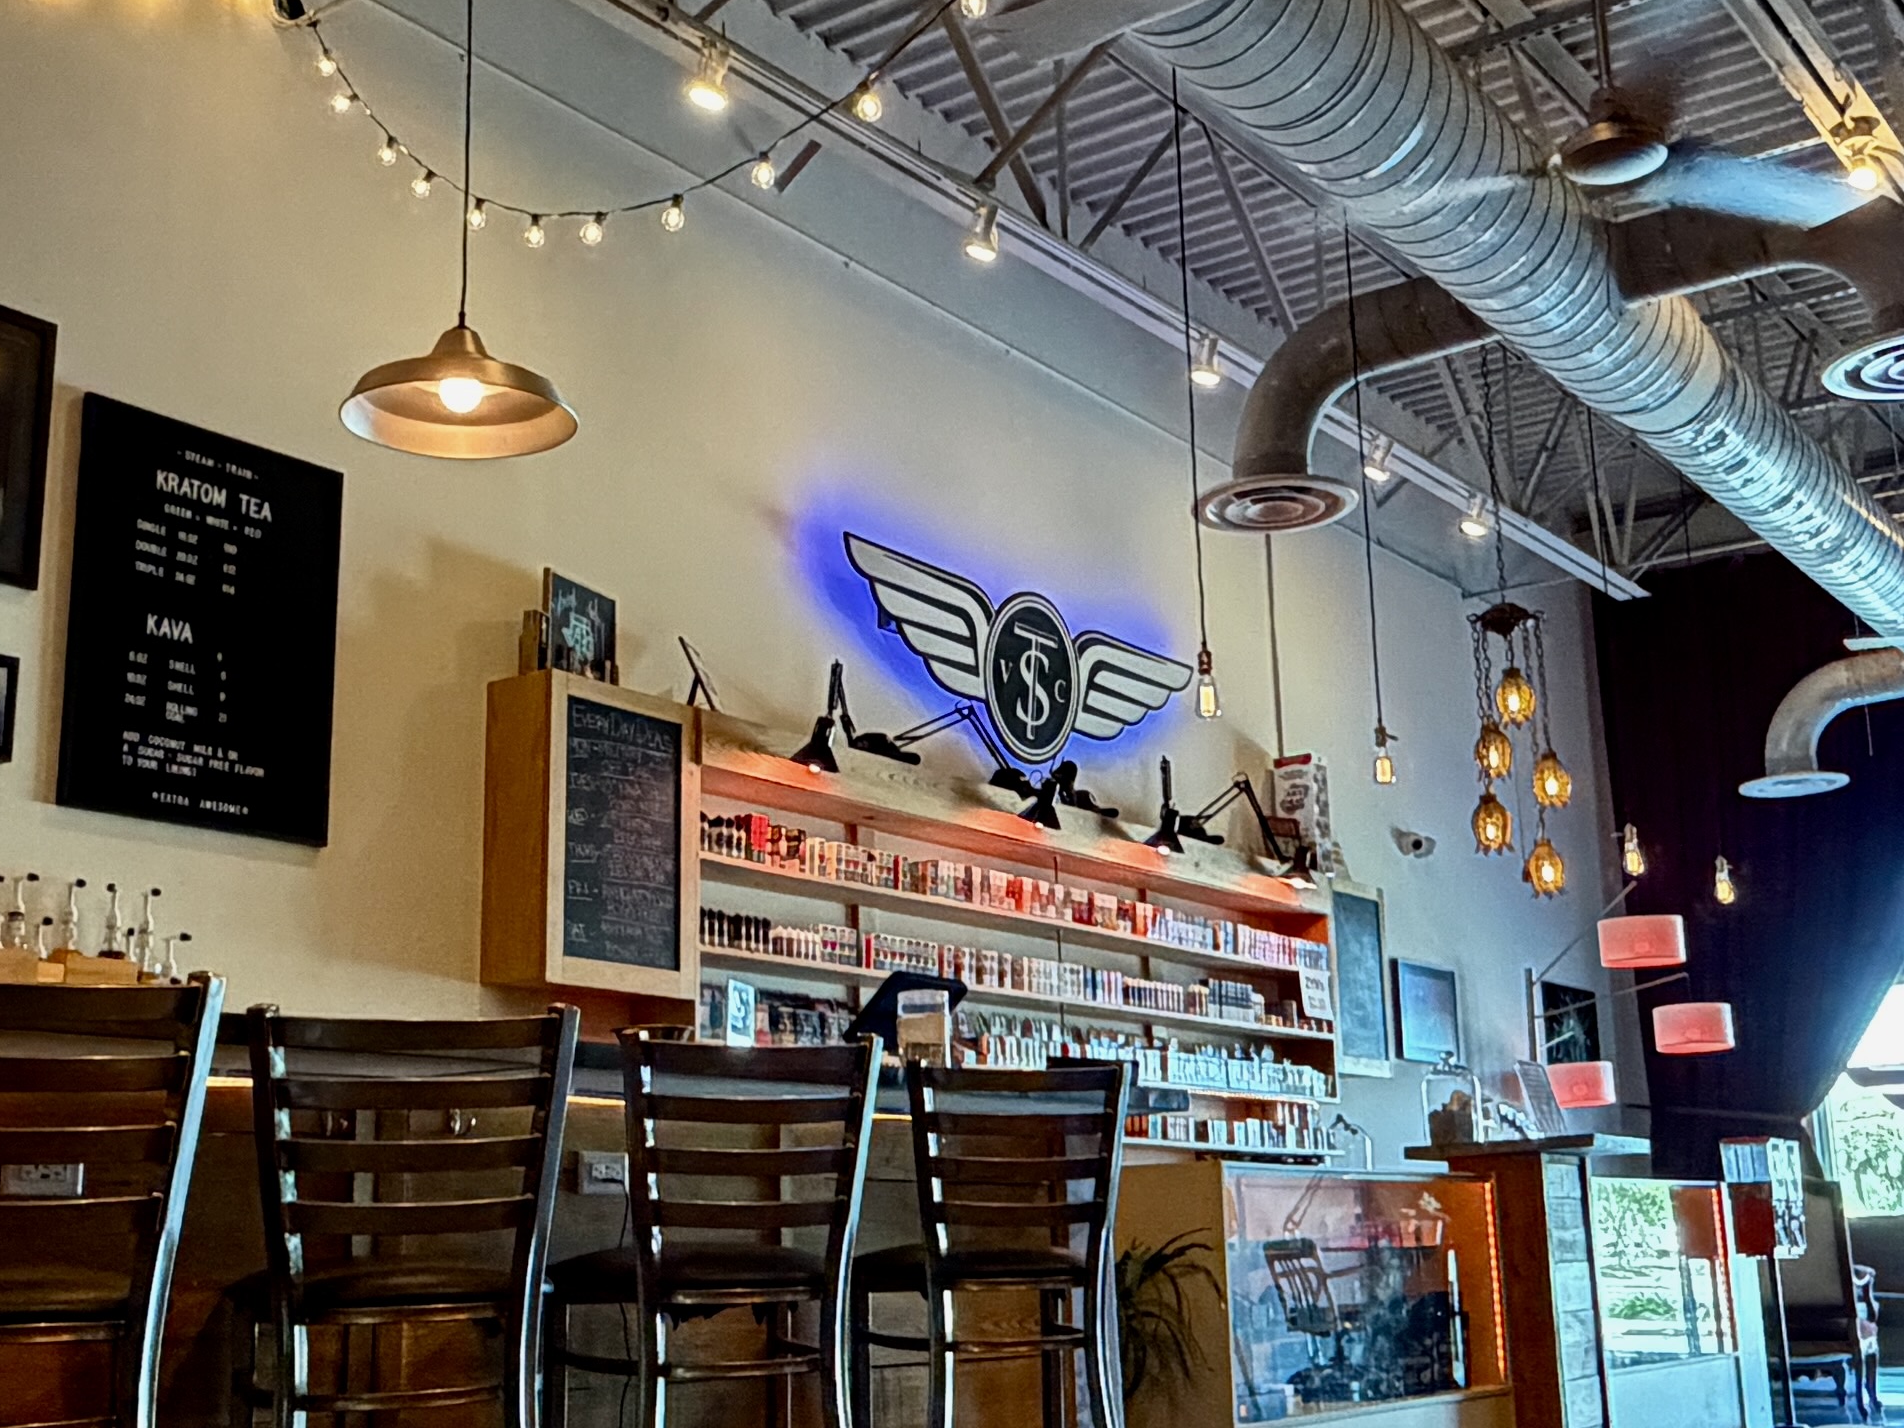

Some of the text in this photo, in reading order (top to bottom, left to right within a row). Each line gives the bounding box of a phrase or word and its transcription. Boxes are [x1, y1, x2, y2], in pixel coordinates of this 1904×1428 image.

[156, 469, 272, 522] KRATOM TEA
[147, 613, 193, 644] KAVA
